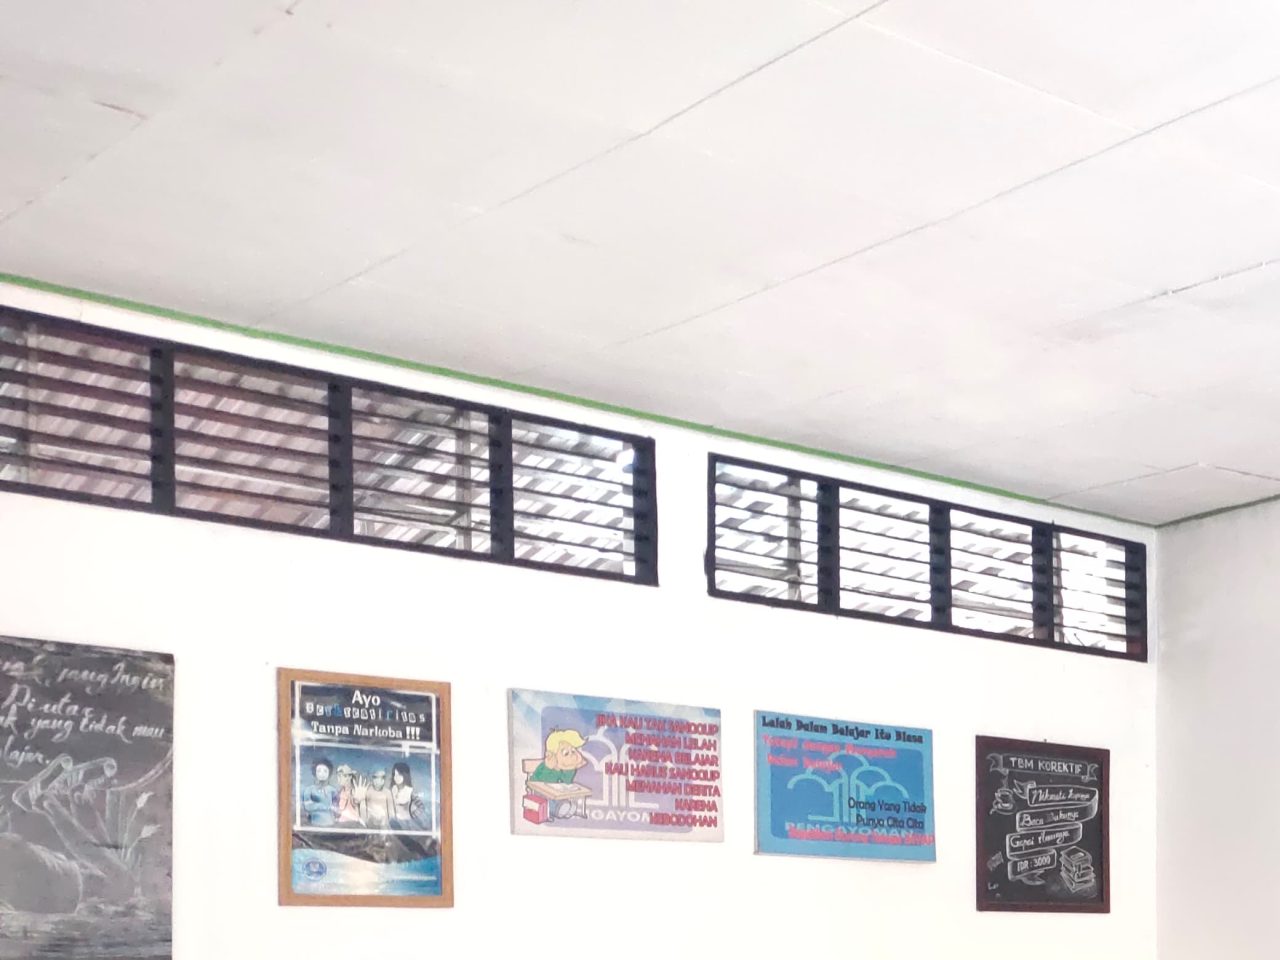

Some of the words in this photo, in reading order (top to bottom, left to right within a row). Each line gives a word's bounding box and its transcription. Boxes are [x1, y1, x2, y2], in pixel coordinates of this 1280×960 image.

[352, 690, 381, 708] Ayo
[24, 717, 75, 743] yang
[311, 721, 349, 736] Tanpa
[353, 724, 403, 738] Narkoba
[0, 735, 50, 768] lajar.
[683, 736, 717, 752] LELAH
[605, 762, 628, 776] KAU
[1010, 757, 1034, 769] TBM
[1038, 760, 1083, 774] KOREKTIF
[848, 797, 876, 811] Orang
[878, 799, 900, 814] Yang
[904, 801, 928, 814] Tidak
[856, 813, 885, 829] Punya
